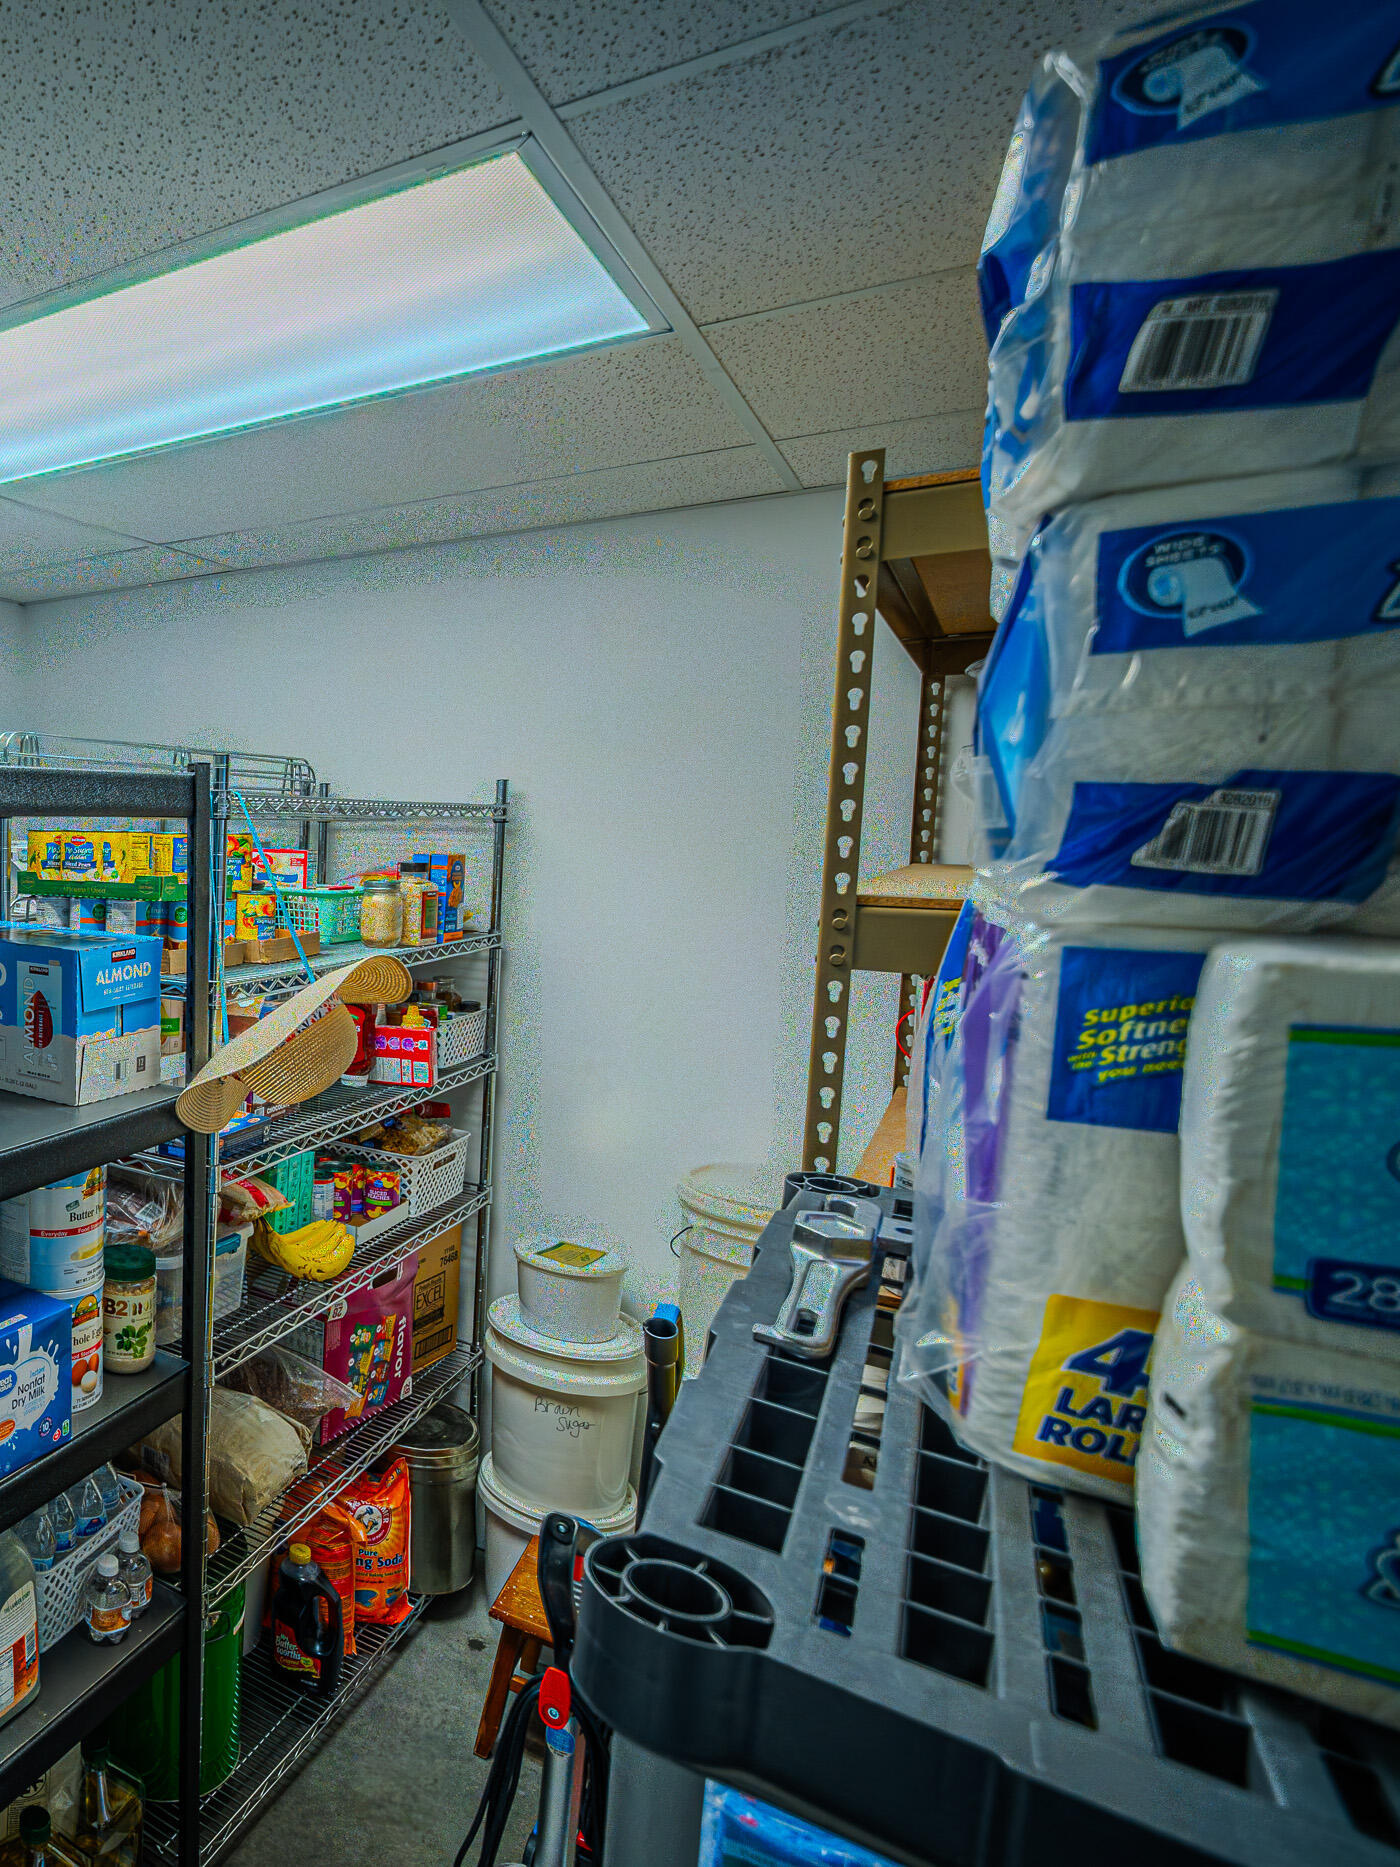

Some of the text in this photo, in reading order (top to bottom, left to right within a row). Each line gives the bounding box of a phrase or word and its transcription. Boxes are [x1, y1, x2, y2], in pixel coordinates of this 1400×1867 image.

[112, 948, 136, 958] KIRKLAND
[96, 961, 152, 986] ALMOND
[23, 977, 35, 1065] ALMOND
[1083, 996, 1196, 1027] Superio
[1076, 1018, 1188, 1049] Softne
[1098, 1038, 1187, 1066] Streng
[1098, 1066, 1137, 1083] you
[69, 1208, 94, 1223] Butter
[78, 1226, 90, 1234] Food
[103, 1300, 128, 1317] B2
[72, 1333, 90, 1347] hole
[394, 1315, 408, 1378] flavor
[29, 1367, 46, 1378] Instant
[1061, 1328, 1154, 1399] 4
[17, 1374, 46, 1397] Nonfat
[11, 1386, 46, 1410] Dry Milk
[534, 1396, 581, 1418] Brown
[1053, 1386, 1148, 1434] LAR
[556, 1416, 596, 1438] Sugar
[1035, 1414, 1140, 1466] ROL
[359, 1548, 378, 1557] Pure
[377, 1553, 403, 1568] Soda
